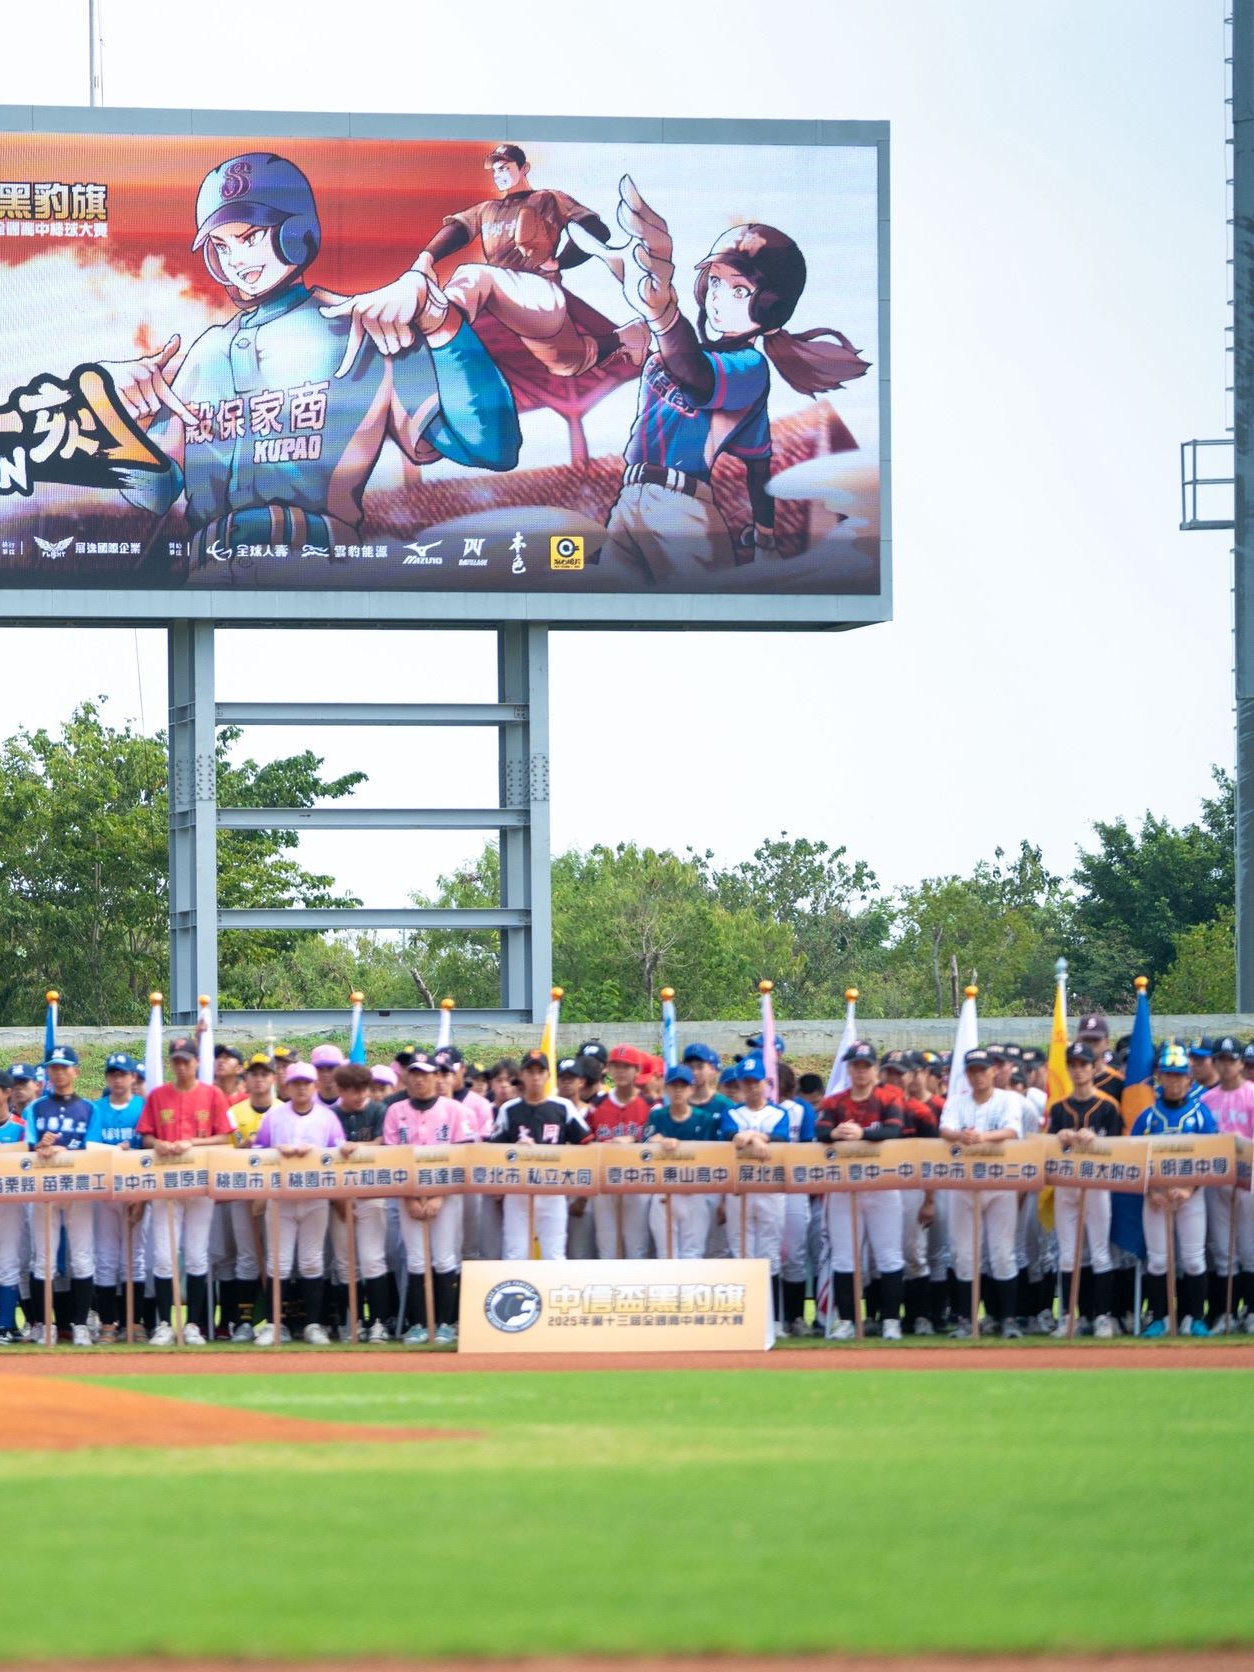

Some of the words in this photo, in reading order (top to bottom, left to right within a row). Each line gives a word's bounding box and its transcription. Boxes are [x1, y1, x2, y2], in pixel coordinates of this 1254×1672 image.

[252, 433, 323, 464] KUPAO
[236, 543, 289, 558] 全球人壽
[215, 1172, 264, 1189] 桃園市
[288, 1171, 337, 1188] 桃園市
[343, 1168, 409, 1186] 六和高中
[417, 1167, 466, 1185] 育達高
[472, 1166, 520, 1184] 臺北市
[526, 1168, 592, 1185] 私立大同
[607, 1166, 656, 1183] 臺中市
[662, 1166, 729, 1184] 東山高中
[792, 1165, 841, 1183] 臺中市
[847, 1163, 914, 1181] 臺中一中
[42, 1173, 107, 1193] 苗栗農工
[547, 1283, 747, 1314] 中信盃黑豹旗
